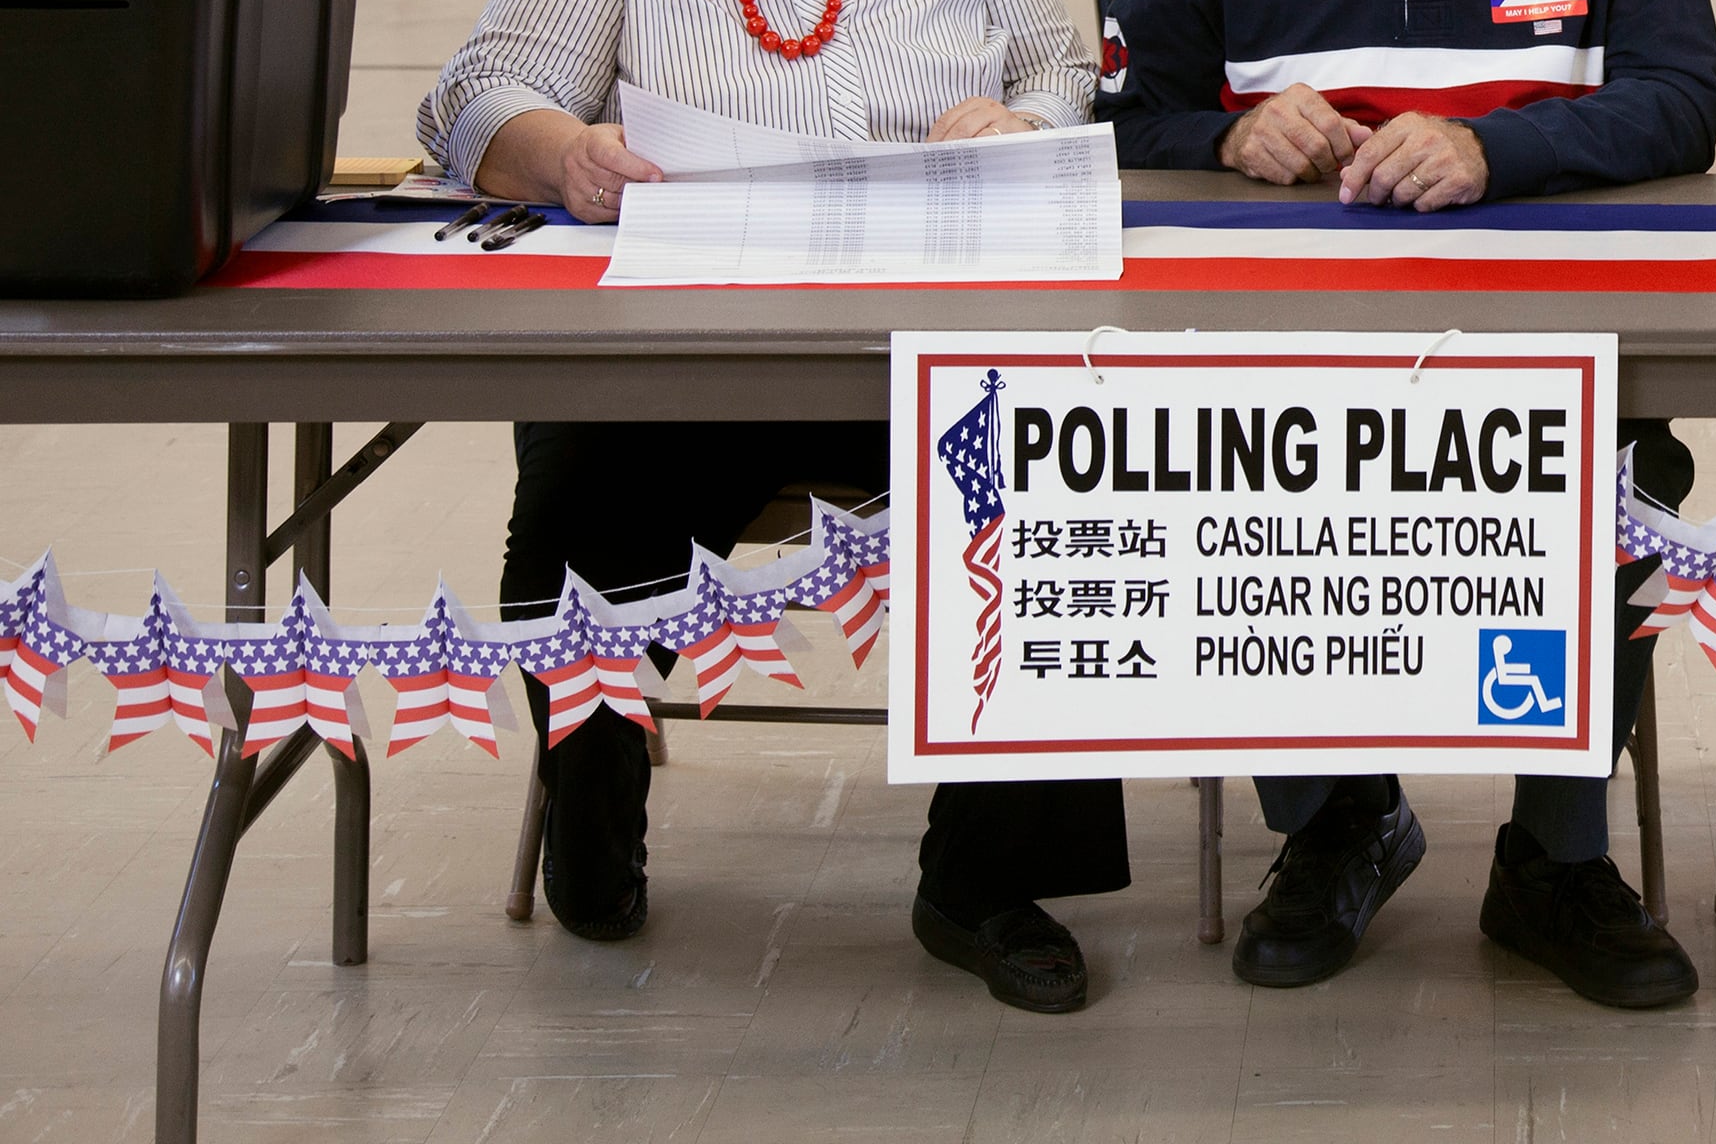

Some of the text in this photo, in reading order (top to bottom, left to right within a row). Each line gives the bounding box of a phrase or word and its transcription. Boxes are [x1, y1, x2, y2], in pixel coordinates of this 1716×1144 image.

[1528, 7, 1549, 15] HELP
[1550, 4, 1571, 12] YOU?
[1013, 406, 1568, 494] POLLING PLACE
[1011, 519, 1168, 559] 投票站
[1196, 516, 1547, 558] CASILLA ELECTORAL
[1013, 579, 1170, 618] 投票所
[1196, 575, 1545, 617] LUGAR NG BOTOHAN
[1019, 639, 1159, 679] 투표소
[1196, 623, 1425, 676] PHÒNG PHIẾU
